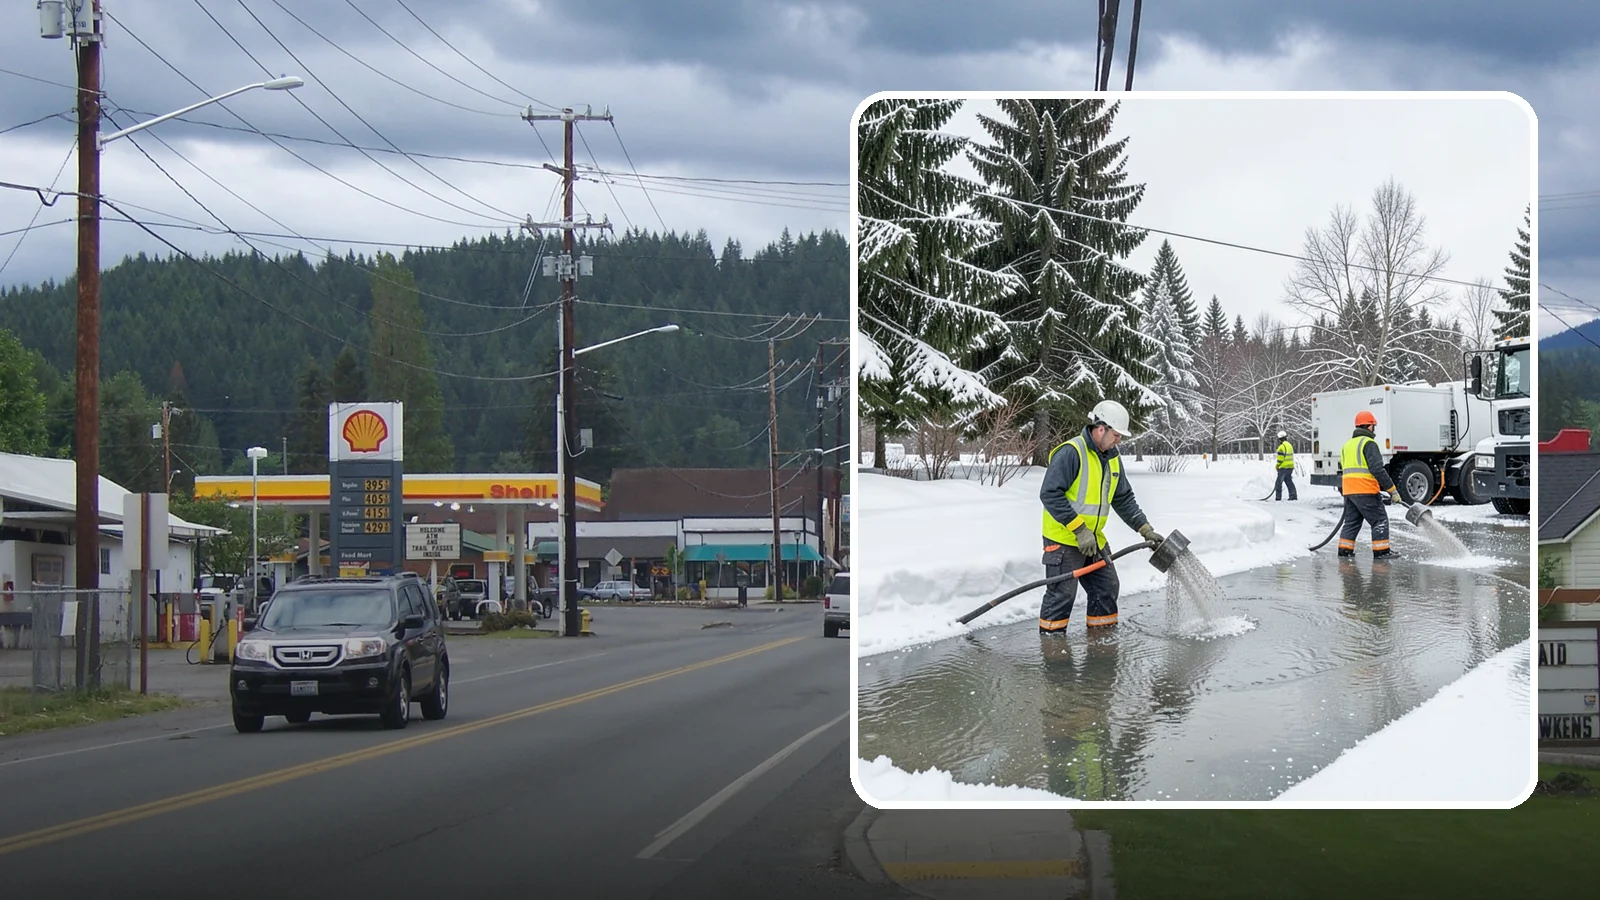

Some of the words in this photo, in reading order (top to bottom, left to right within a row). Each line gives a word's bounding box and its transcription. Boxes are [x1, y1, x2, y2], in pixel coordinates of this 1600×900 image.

[365, 480, 383, 490] 395
[490, 484, 547, 499] Shell
[365, 494, 383, 504] 405
[365, 508, 383, 518] 415
[365, 522, 383, 533] 429
[1539, 642, 1567, 665] AID
[1539, 716, 1592, 738] WKENS
